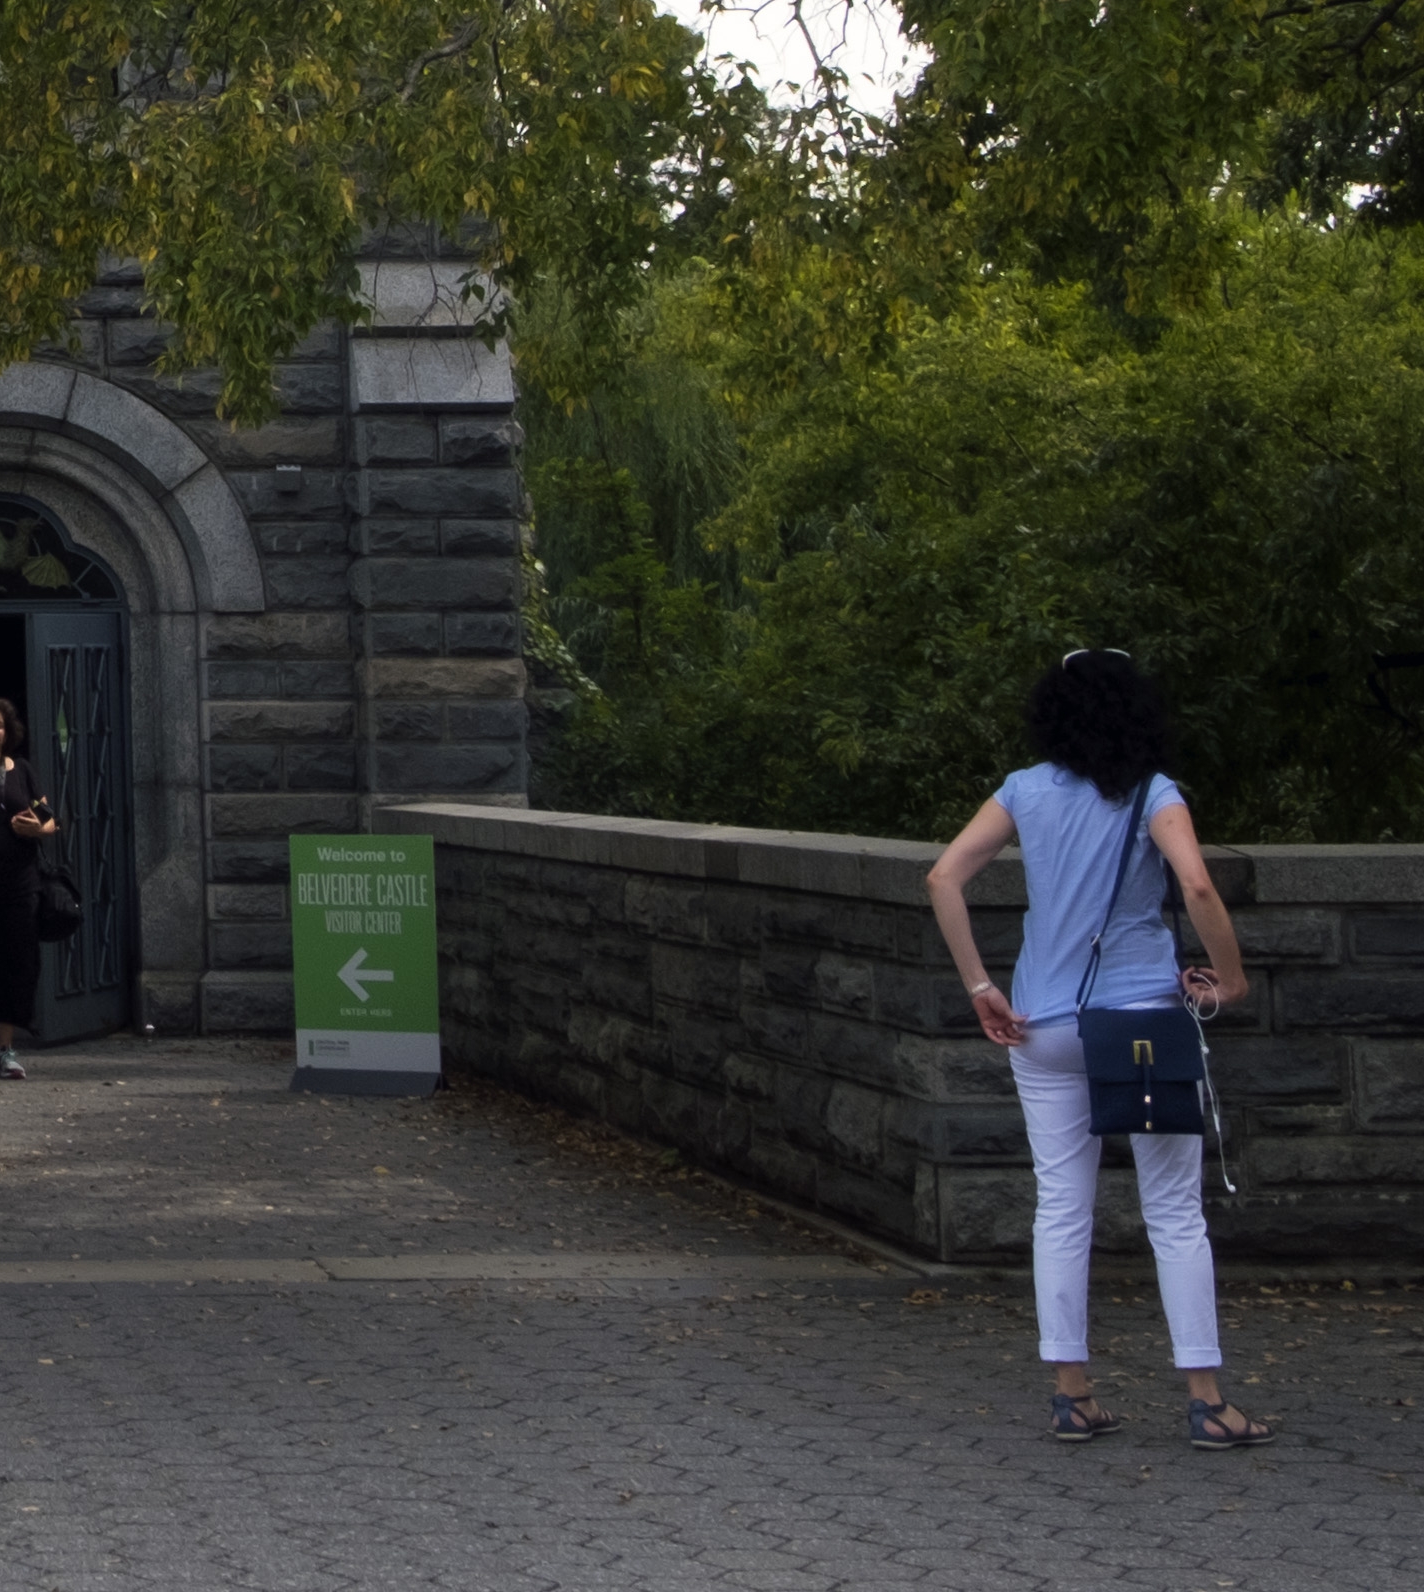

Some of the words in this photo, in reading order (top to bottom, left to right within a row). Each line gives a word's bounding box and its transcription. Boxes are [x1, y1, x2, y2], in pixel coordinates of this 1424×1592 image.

[317, 847, 386, 862] Welcome
[390, 849, 406, 862] to
[298, 873, 372, 906] BELVEDERE
[377, 874, 428, 906] CASTLE
[325, 910, 363, 933] VISITOR
[365, 911, 402, 934] CENTER
